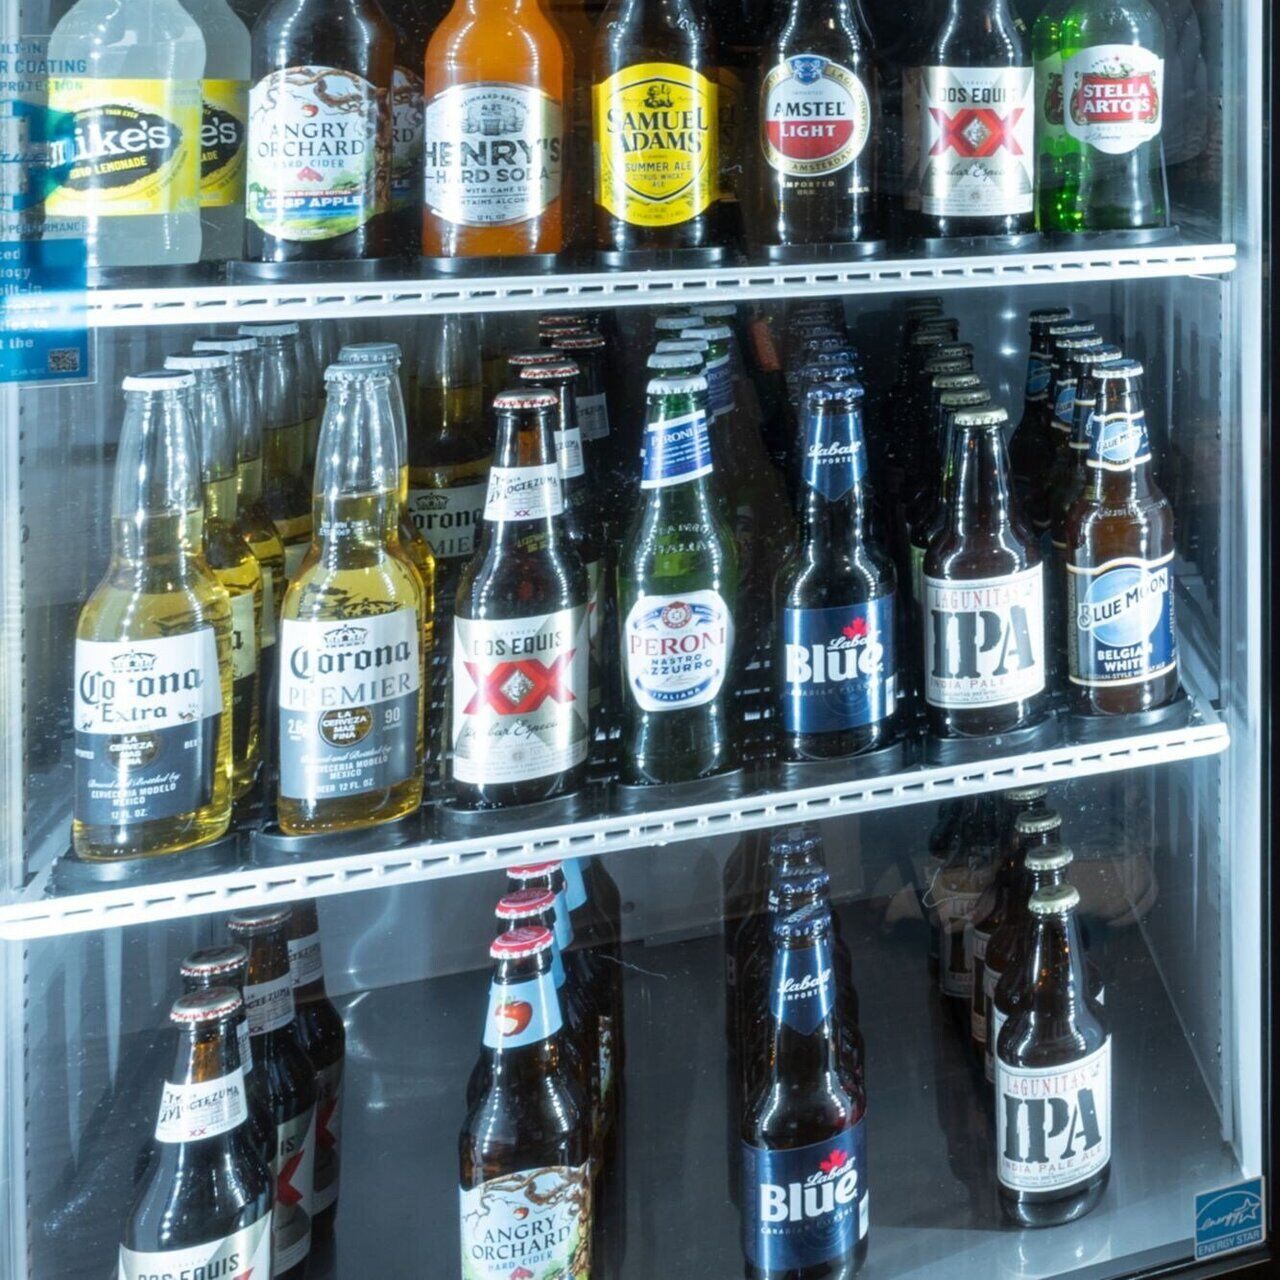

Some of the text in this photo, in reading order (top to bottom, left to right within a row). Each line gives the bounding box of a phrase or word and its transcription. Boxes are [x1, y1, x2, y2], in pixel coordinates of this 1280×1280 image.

[15, 59, 87, 74] COATING
[1083, 83, 1150, 99] STELLA
[773, 101, 845, 117] AMSTEL
[1081, 98, 1151, 114] ARTOIS
[607, 108, 709, 134] SAMUEL
[269, 122, 349, 140] ANGRY
[779, 123, 836, 139] LIGHT
[257, 140, 366, 159] ORCHARD
[425, 135, 561, 167] HENRY'S
[619, 131, 702, 154] ADAMS
[96, 156, 148, 174] LEMONADE
[626, 161, 692, 172] SUMMER ALE
[436, 169, 493, 185] HARD
[311, 194, 363, 208] APPLE
[1124, 574, 1167, 607] MOON
[511, 632, 563, 654] EQUIS
[630, 628, 727, 656] PERONI
[930, 605, 1035, 680] IPA
[289, 640, 412, 682] Corona
[651, 654, 702, 666] NASTRO
[785, 640, 884, 684] Blue
[1097, 643, 1152, 663] BELGIAN
[1104, 659, 1147, 673] WHITE
[102, 702, 168, 724] Extra
[322, 715, 367, 727] CERVEZA
[385, 707, 401, 724] 90
[1001, 1086, 1103, 1165] IPA
[759, 1173, 858, 1223] Blue
[483, 1218, 556, 1245] ANGRY
[470, 1225, 570, 1264] ORCHARD
[1198, 1231, 1261, 1256] ENERGY STAR
[521, 1252, 553, 1267] CIDER
